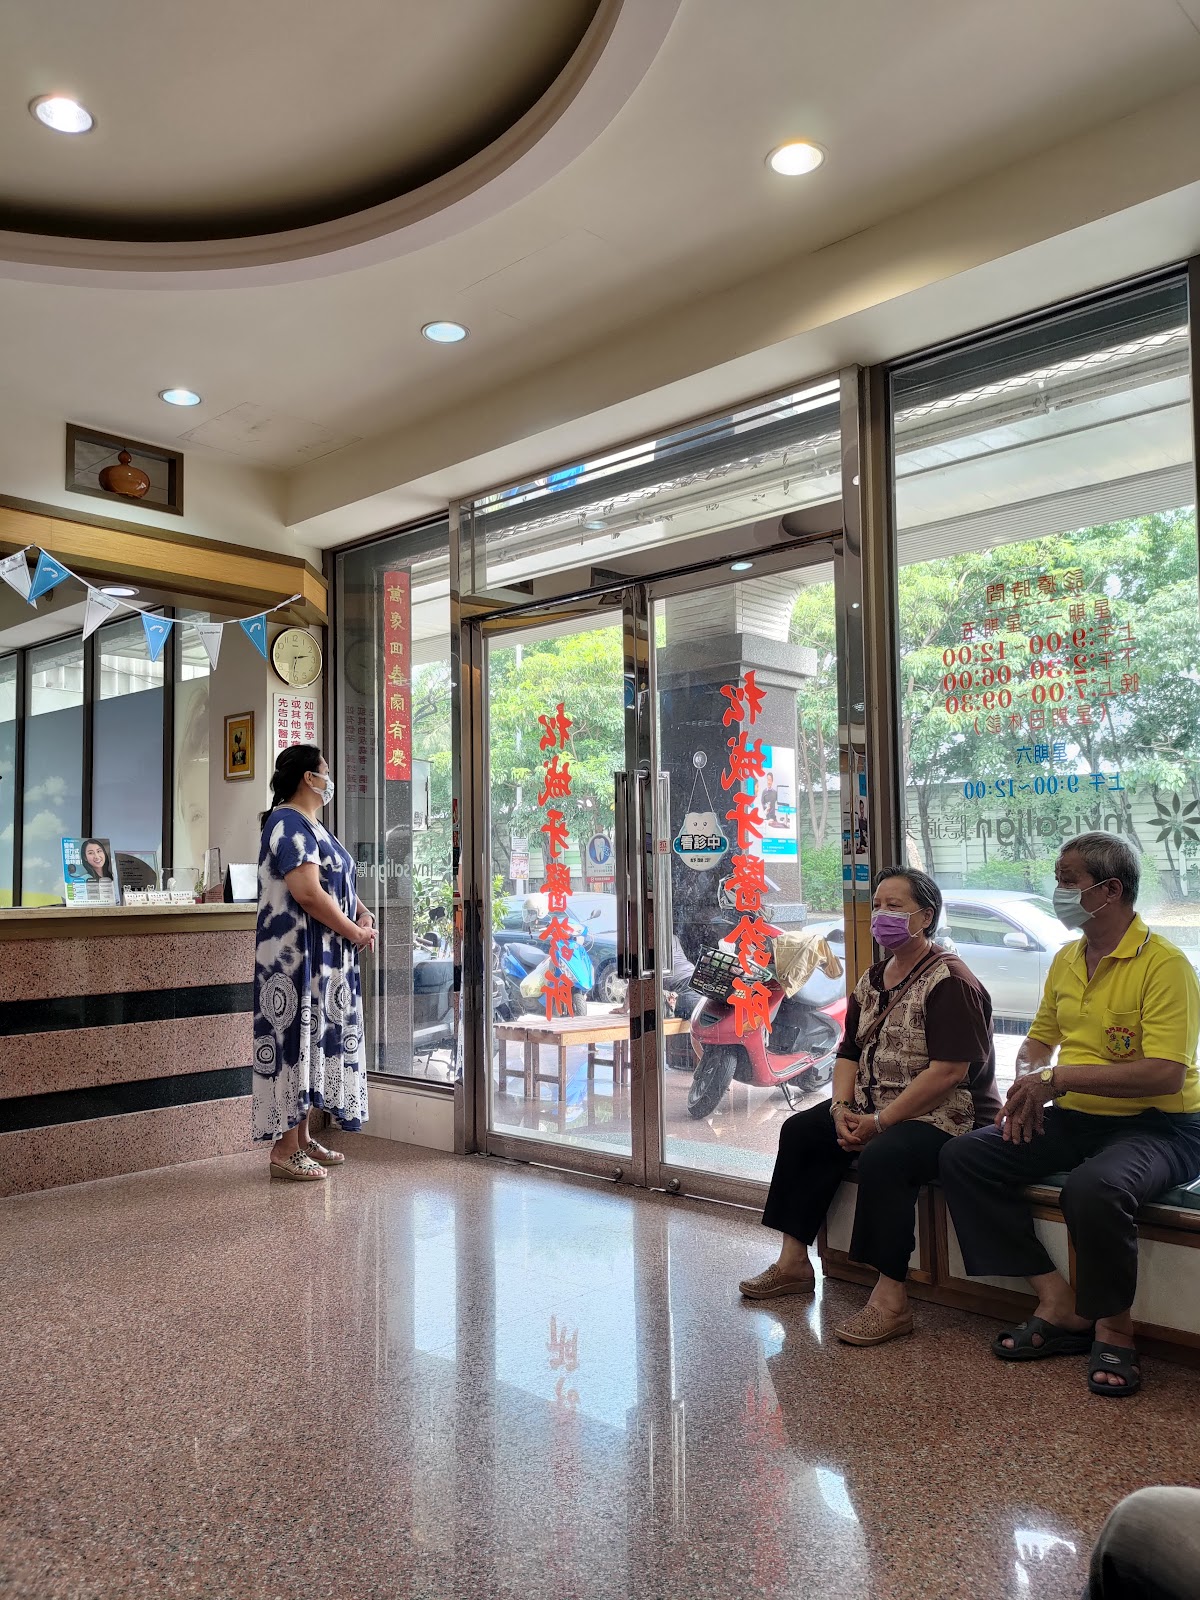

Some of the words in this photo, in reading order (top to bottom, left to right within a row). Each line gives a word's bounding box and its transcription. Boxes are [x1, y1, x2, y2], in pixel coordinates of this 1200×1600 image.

[278, 698, 289, 749] 先告知醫師
[304, 701, 315, 741] 如有懷孕
[681, 834, 721, 850] 看診中
